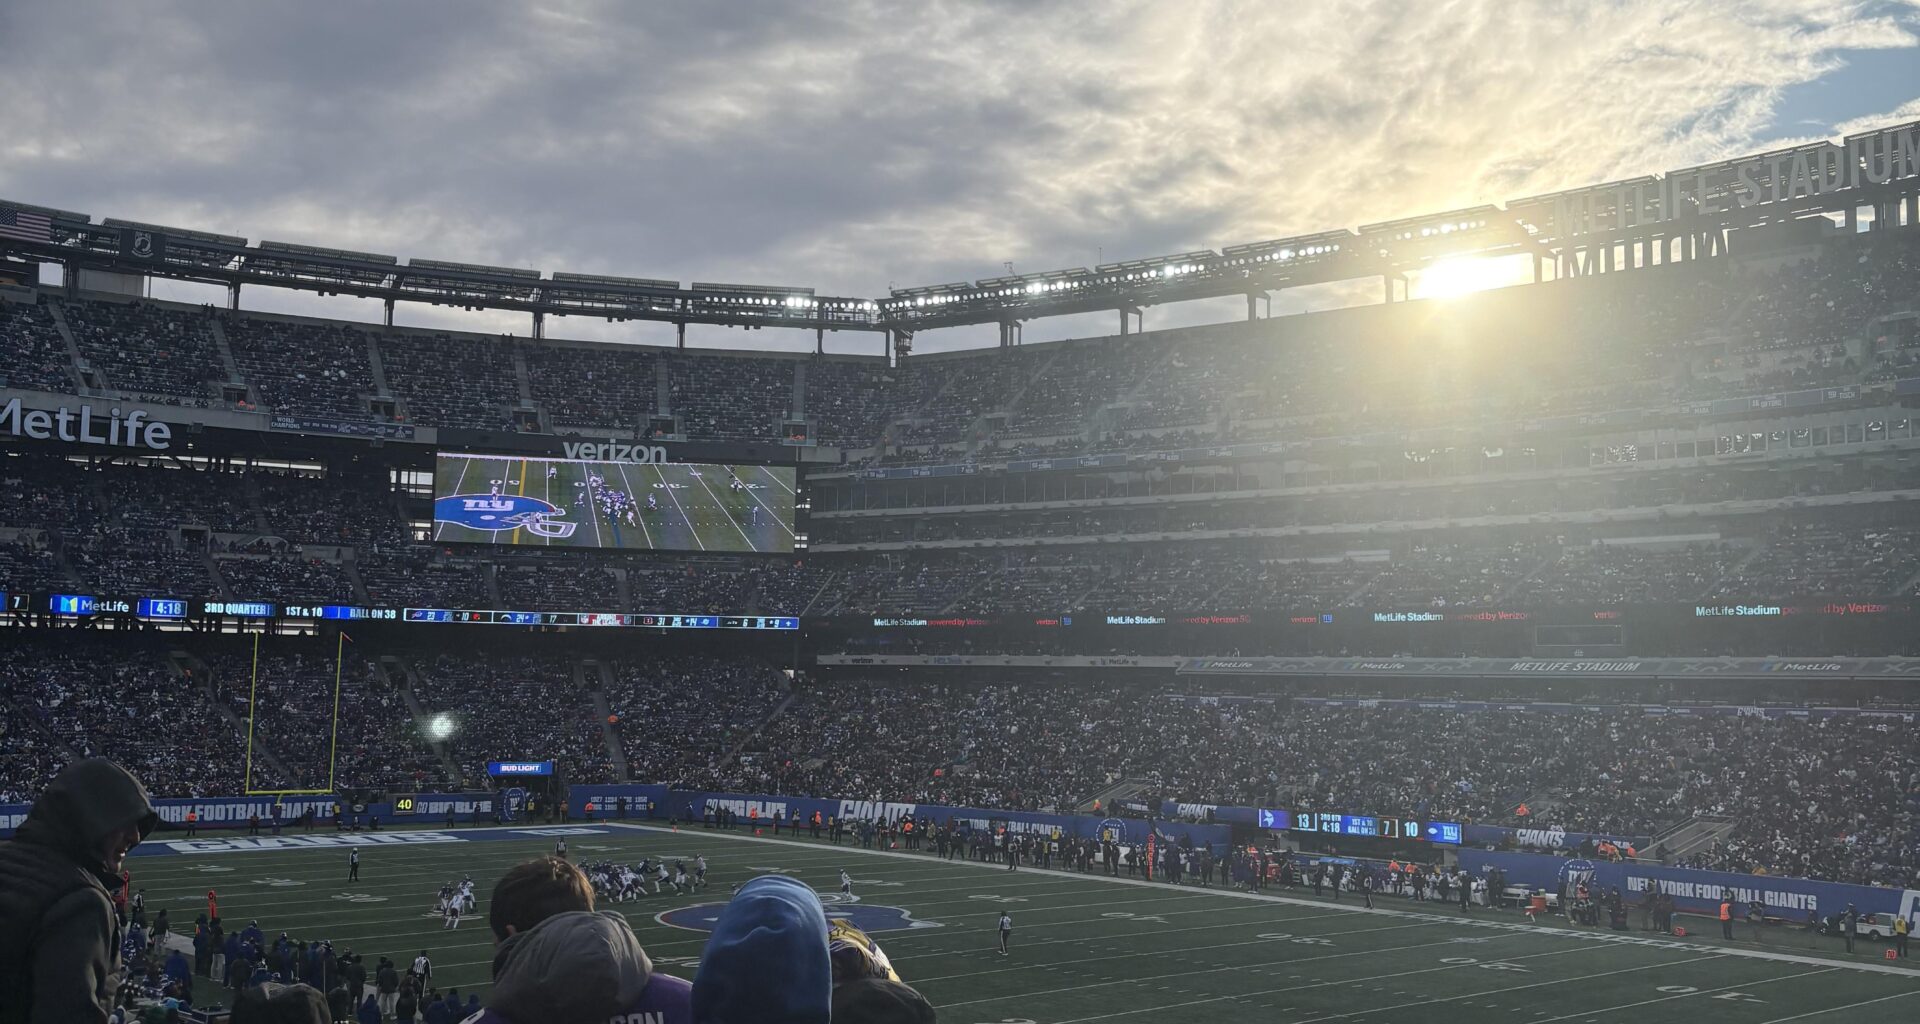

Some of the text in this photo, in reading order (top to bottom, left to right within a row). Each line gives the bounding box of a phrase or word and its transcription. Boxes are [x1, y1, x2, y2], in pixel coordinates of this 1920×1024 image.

[562, 438, 667, 463] verizon
[81, 600, 130, 612] MetLife
[156, 602, 182, 615] 4:18
[205, 602, 267, 615] 3RD QUARTER
[285, 606, 301, 616] 1ST
[311, 607, 323, 617] 10
[1695, 606, 1735, 616] MetLife
[1735, 605, 1781, 616] Stadium
[1833, 603, 1846, 616] by
[350, 607, 396, 619] BALL ON 38
[1374, 613, 1407, 622] MetLife
[1407, 612, 1444, 622] Stadium
[874, 618, 900, 627] MetLife
[900, 618, 927, 626] Stadium
[1107, 616, 1135, 625] MetLife
[1135, 616, 1166, 624] Stadium
[1211, 661, 1253, 669] MetLife
[1360, 661, 1405, 671] MetLife
[1509, 661, 1642, 672] METLIFE STADIUM
[1783, 663, 1842, 672] MetLife
[397, 799, 412, 810] 40
[194, 803, 273, 822] FOOTBALL
[1296, 813, 1309, 828] 13
[1322, 821, 1340, 833] 4:18
[1383, 820, 1390, 835] 7
[1404, 821, 1418, 837] 10
[1659, 879, 1696, 898] YORK
[1764, 889, 1817, 910] GIANTS
